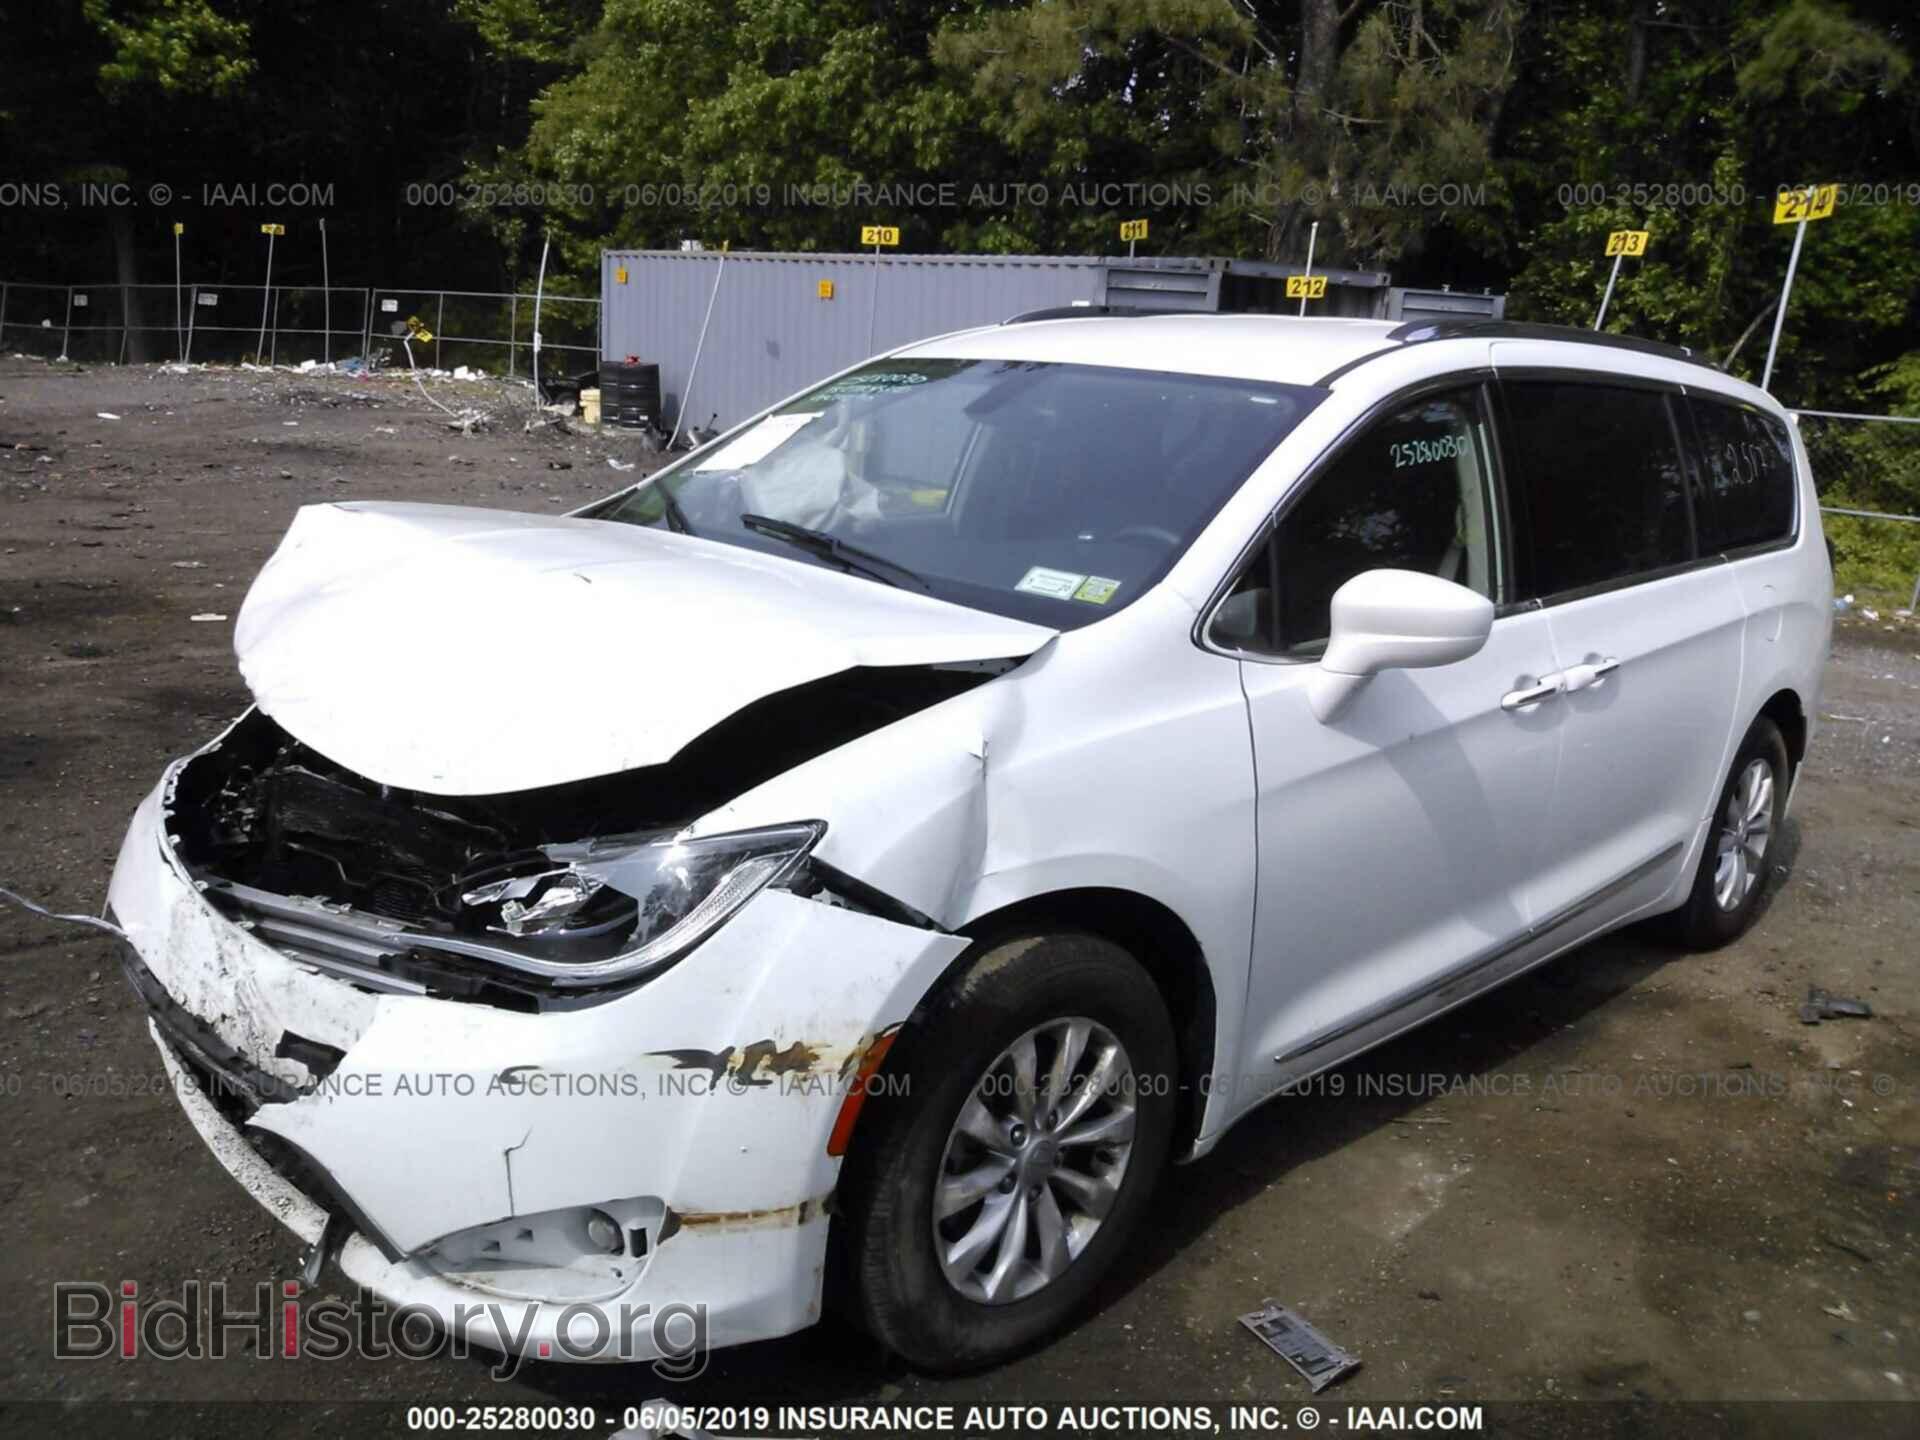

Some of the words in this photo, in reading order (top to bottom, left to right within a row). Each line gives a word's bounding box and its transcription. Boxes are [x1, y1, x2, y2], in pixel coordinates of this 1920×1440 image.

[867, 229, 893, 242] 210
[1611, 233, 1639, 252] 213
[1291, 279, 1323, 295] 212
[1390, 435, 1466, 468] 25280030
